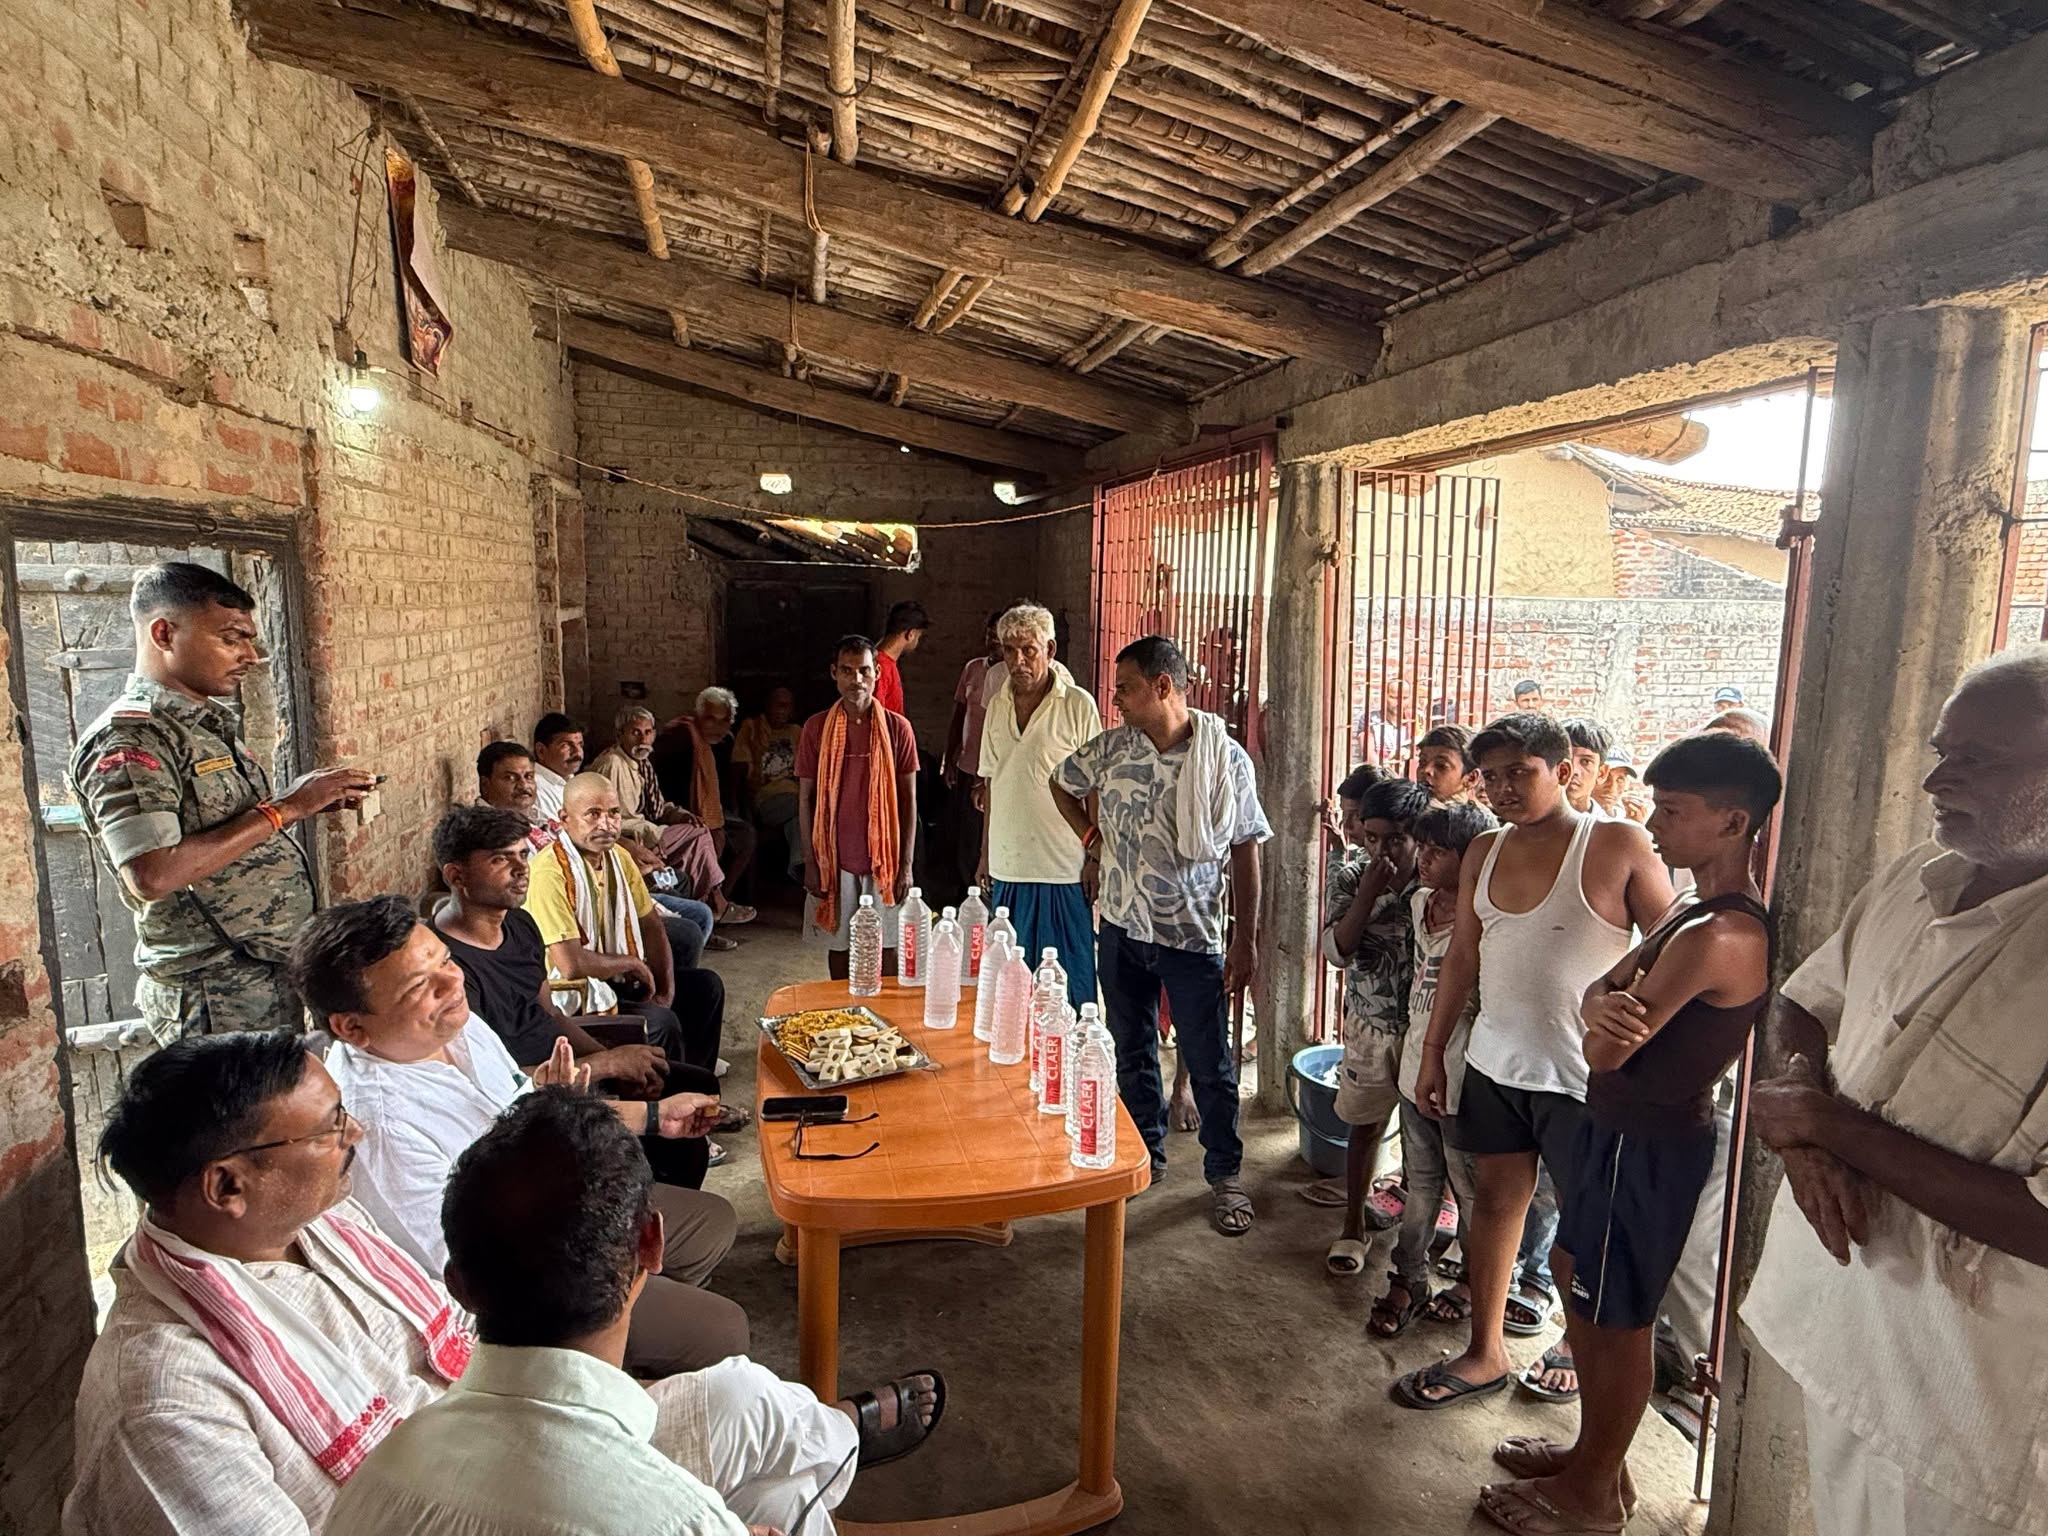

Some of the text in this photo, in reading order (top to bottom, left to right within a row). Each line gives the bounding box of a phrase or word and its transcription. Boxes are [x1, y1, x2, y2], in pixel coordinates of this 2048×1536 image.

[905, 926, 914, 960] CLAER
[971, 926, 981, 960] CLAER
[1047, 1039, 1059, 1081] CLAER
[1080, 1082, 1094, 1129] CLAER
